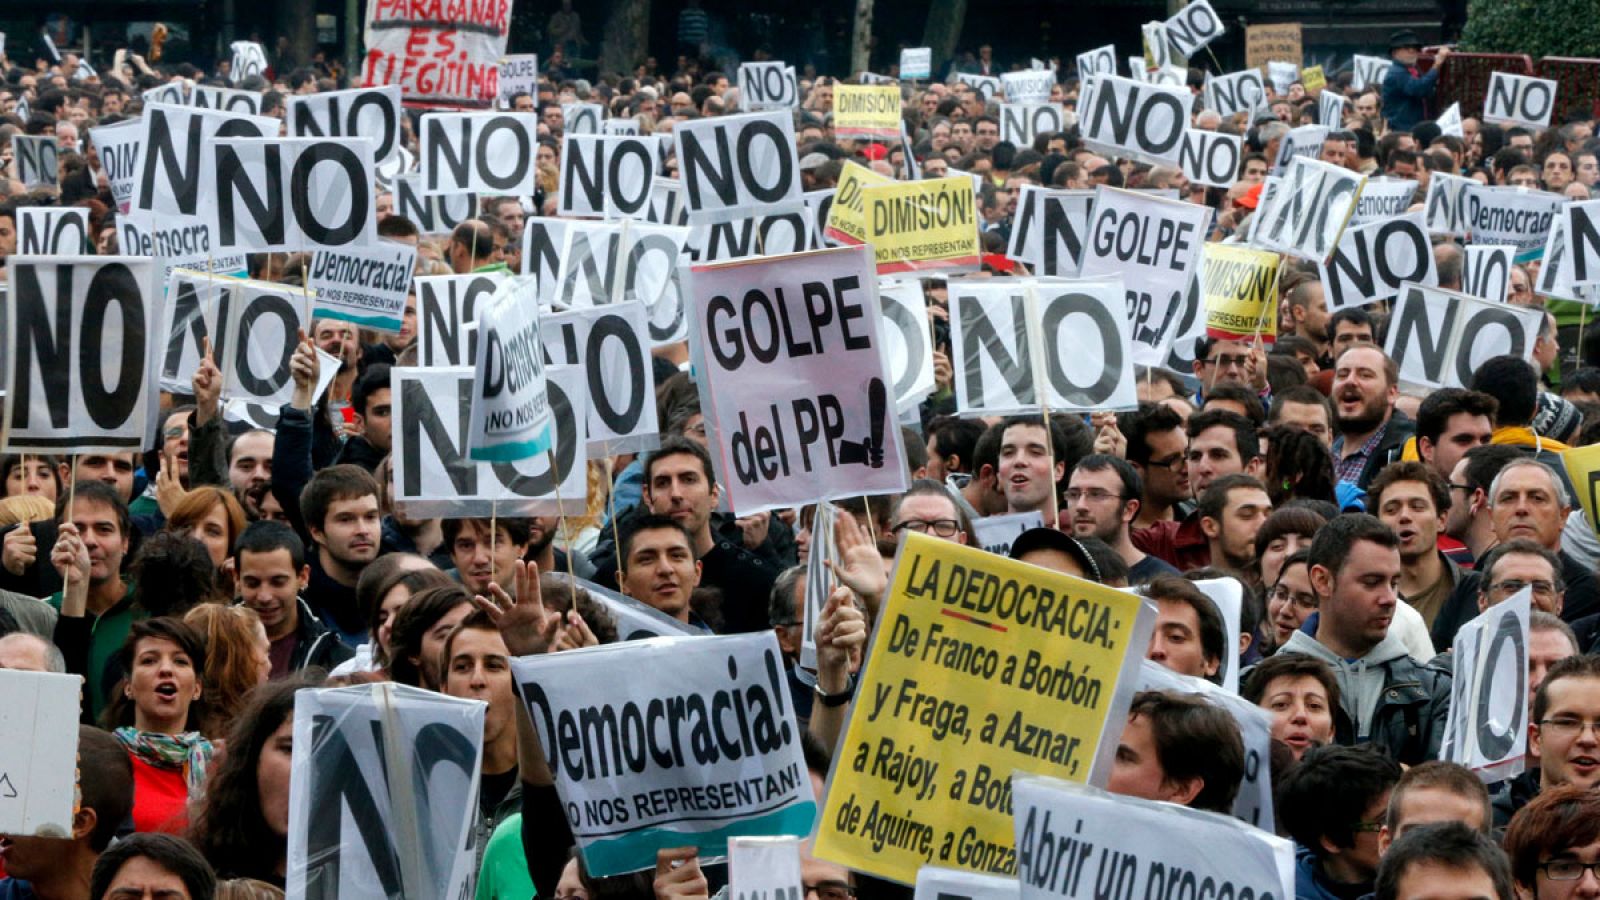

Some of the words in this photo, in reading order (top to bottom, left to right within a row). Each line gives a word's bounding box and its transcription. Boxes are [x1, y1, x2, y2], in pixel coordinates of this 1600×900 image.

[406, 27, 458, 58] ES
[1079, 50, 1113, 79] NO
[1166, 5, 1217, 56] NO
[501, 60, 534, 77] GOLPE
[745, 66, 785, 102] NO
[839, 89, 899, 113] DIMISIÓN!
[1212, 74, 1262, 116] NO
[1488, 78, 1551, 121] NO
[294, 91, 396, 163] NO
[1004, 106, 1061, 145] NO
[1088, 79, 1185, 155] NO
[19, 138, 58, 185] NO
[427, 116, 530, 190] NO
[564, 139, 653, 214] NO
[680, 120, 793, 210] NO
[1178, 132, 1238, 184] NO
[215, 142, 369, 246] NO
[398, 179, 477, 232] NO
[874, 184, 973, 236] DIMISIÓN!
[23, 210, 85, 255] NO
[875, 249, 889, 260] NO
[891, 247, 911, 259] NOS
[912, 239, 974, 257] REPRESENTAN!
[1093, 208, 1195, 271] GOLPE
[1328, 219, 1429, 305] NO
[313, 251, 414, 292] Democracia!
[11, 262, 146, 430] NO
[162, 281, 300, 396] NO
[706, 275, 871, 371] GOLPE
[957, 293, 1124, 408] NO
[1391, 287, 1525, 389] NO
[401, 378, 578, 497] NO
[484, 410, 513, 434] ¡NO
[731, 403, 790, 486] del
[906, 553, 940, 599] LA
[942, 565, 1121, 650] DEDOCRACIA:
[887, 613, 919, 658] De
[920, 625, 996, 680] Franco
[1000, 654, 1018, 685] a
[1019, 649, 1102, 710] Borbón
[522, 648, 793, 782] Democracia!
[867, 681, 892, 723] y
[893, 679, 971, 741] Fraga,
[979, 714, 998, 743] a
[999, 710, 1080, 774] Aznar,
[586, 796, 630, 827] NOS
[635, 762, 801, 820] REPRESENTAN!
[852, 742, 871, 773] a
[871, 737, 938, 802] Rajoy,
[949, 769, 968, 800] a
[306, 714, 478, 900] NO
[835, 792, 858, 835] de
[859, 801, 934, 863] Aguirre,
[938, 831, 953, 862] a
[1021, 805, 1093, 898] Abrir
[1094, 848, 1138, 900] un
